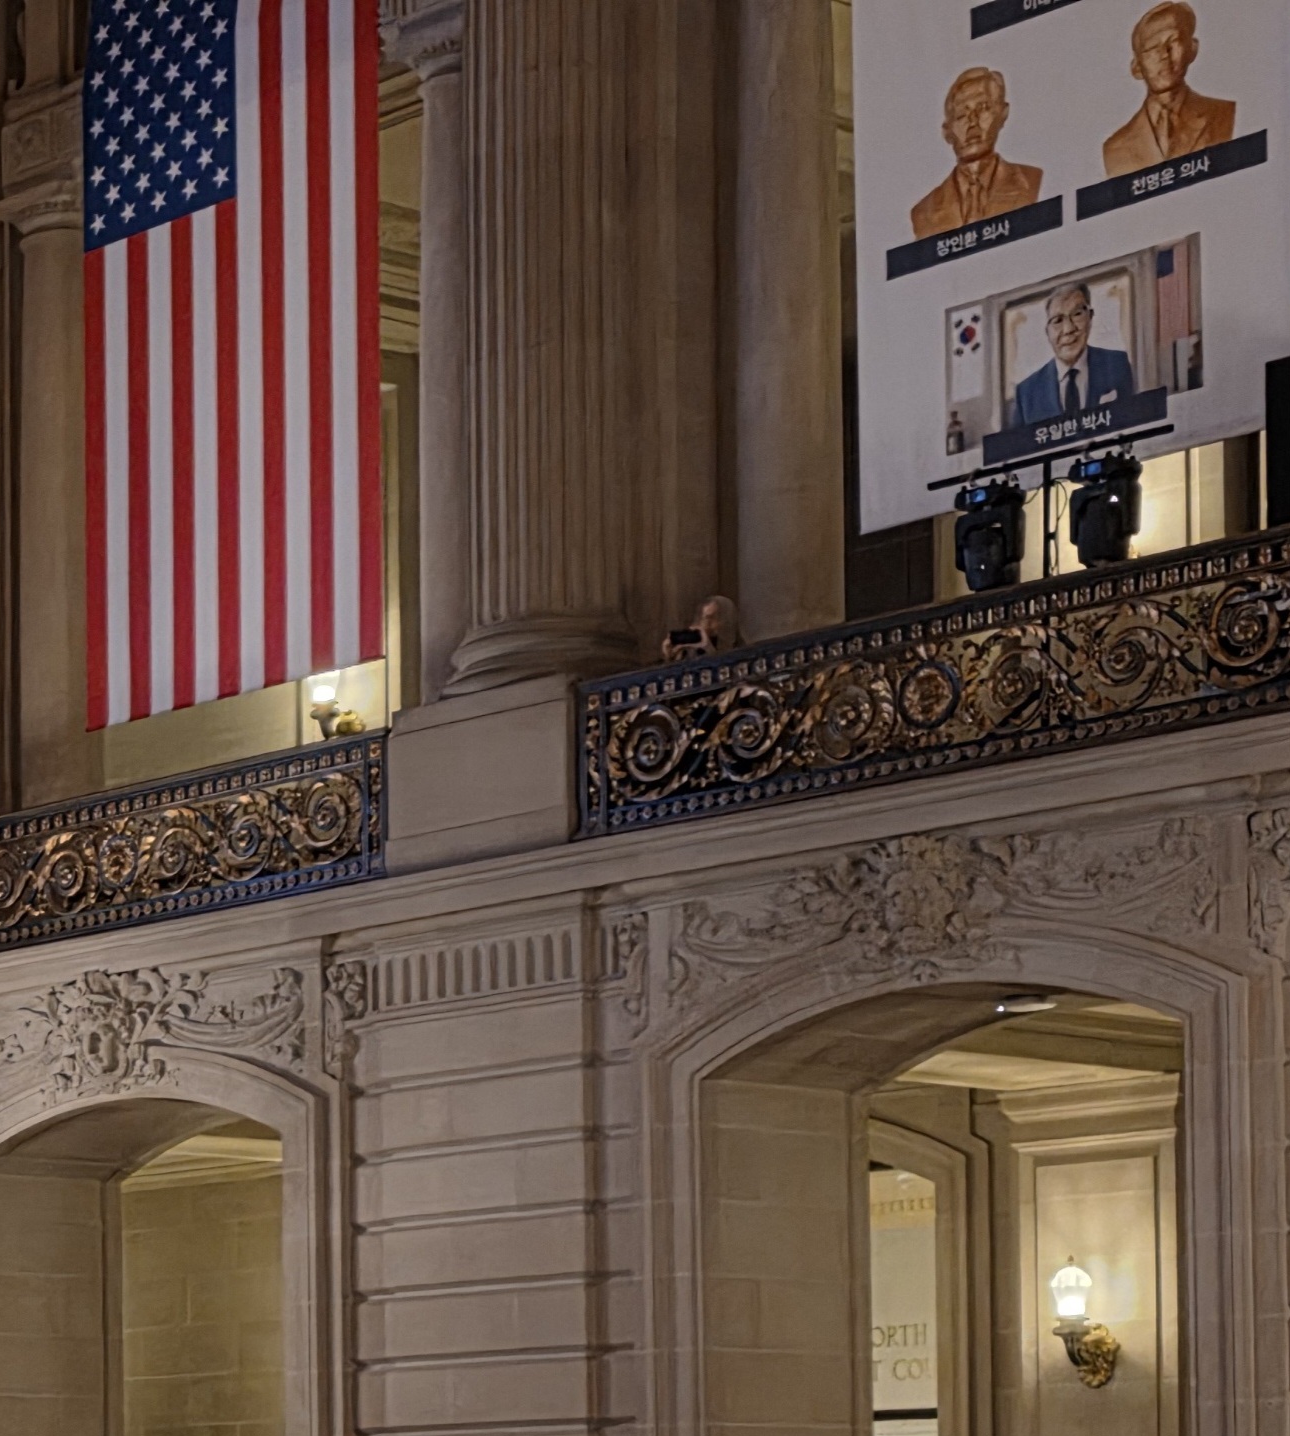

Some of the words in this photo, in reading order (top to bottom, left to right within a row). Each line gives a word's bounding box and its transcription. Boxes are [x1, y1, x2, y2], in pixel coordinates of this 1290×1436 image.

[1180, 155, 1211, 177] 의사
[981, 218, 1011, 241] 의사
[1034, 418, 1078, 445] 유일한
[1081, 409, 1112, 430] 박사
[871, 1323, 927, 1348] ORTH
